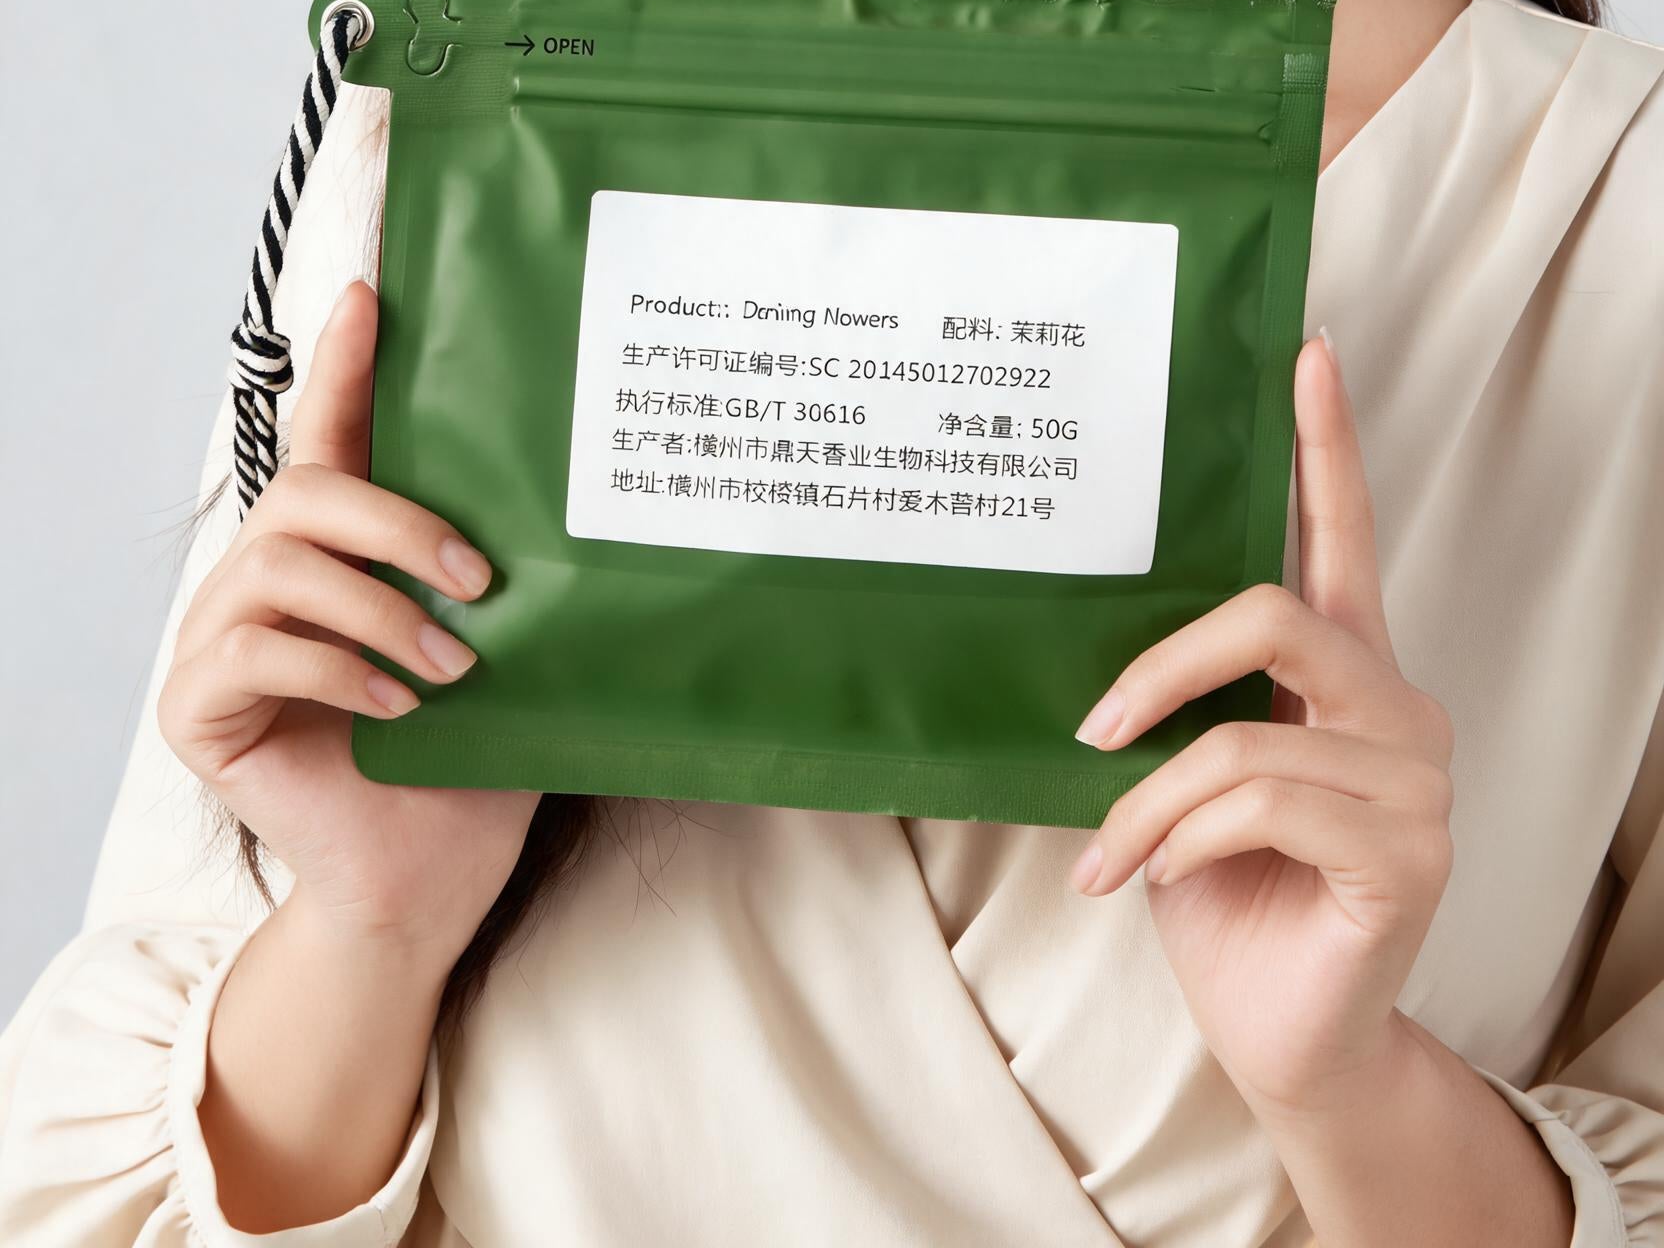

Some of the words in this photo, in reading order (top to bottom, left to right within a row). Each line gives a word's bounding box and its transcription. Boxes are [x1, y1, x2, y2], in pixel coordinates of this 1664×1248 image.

[543, 37, 595, 56] OPEN
[823, 307, 899, 329] Nowers
[1010, 320, 1086, 348] 茉莉花
[848, 359, 1051, 389] 20145012702922
[793, 402, 866, 425] 30616
[1031, 417, 1078, 441] 50G
